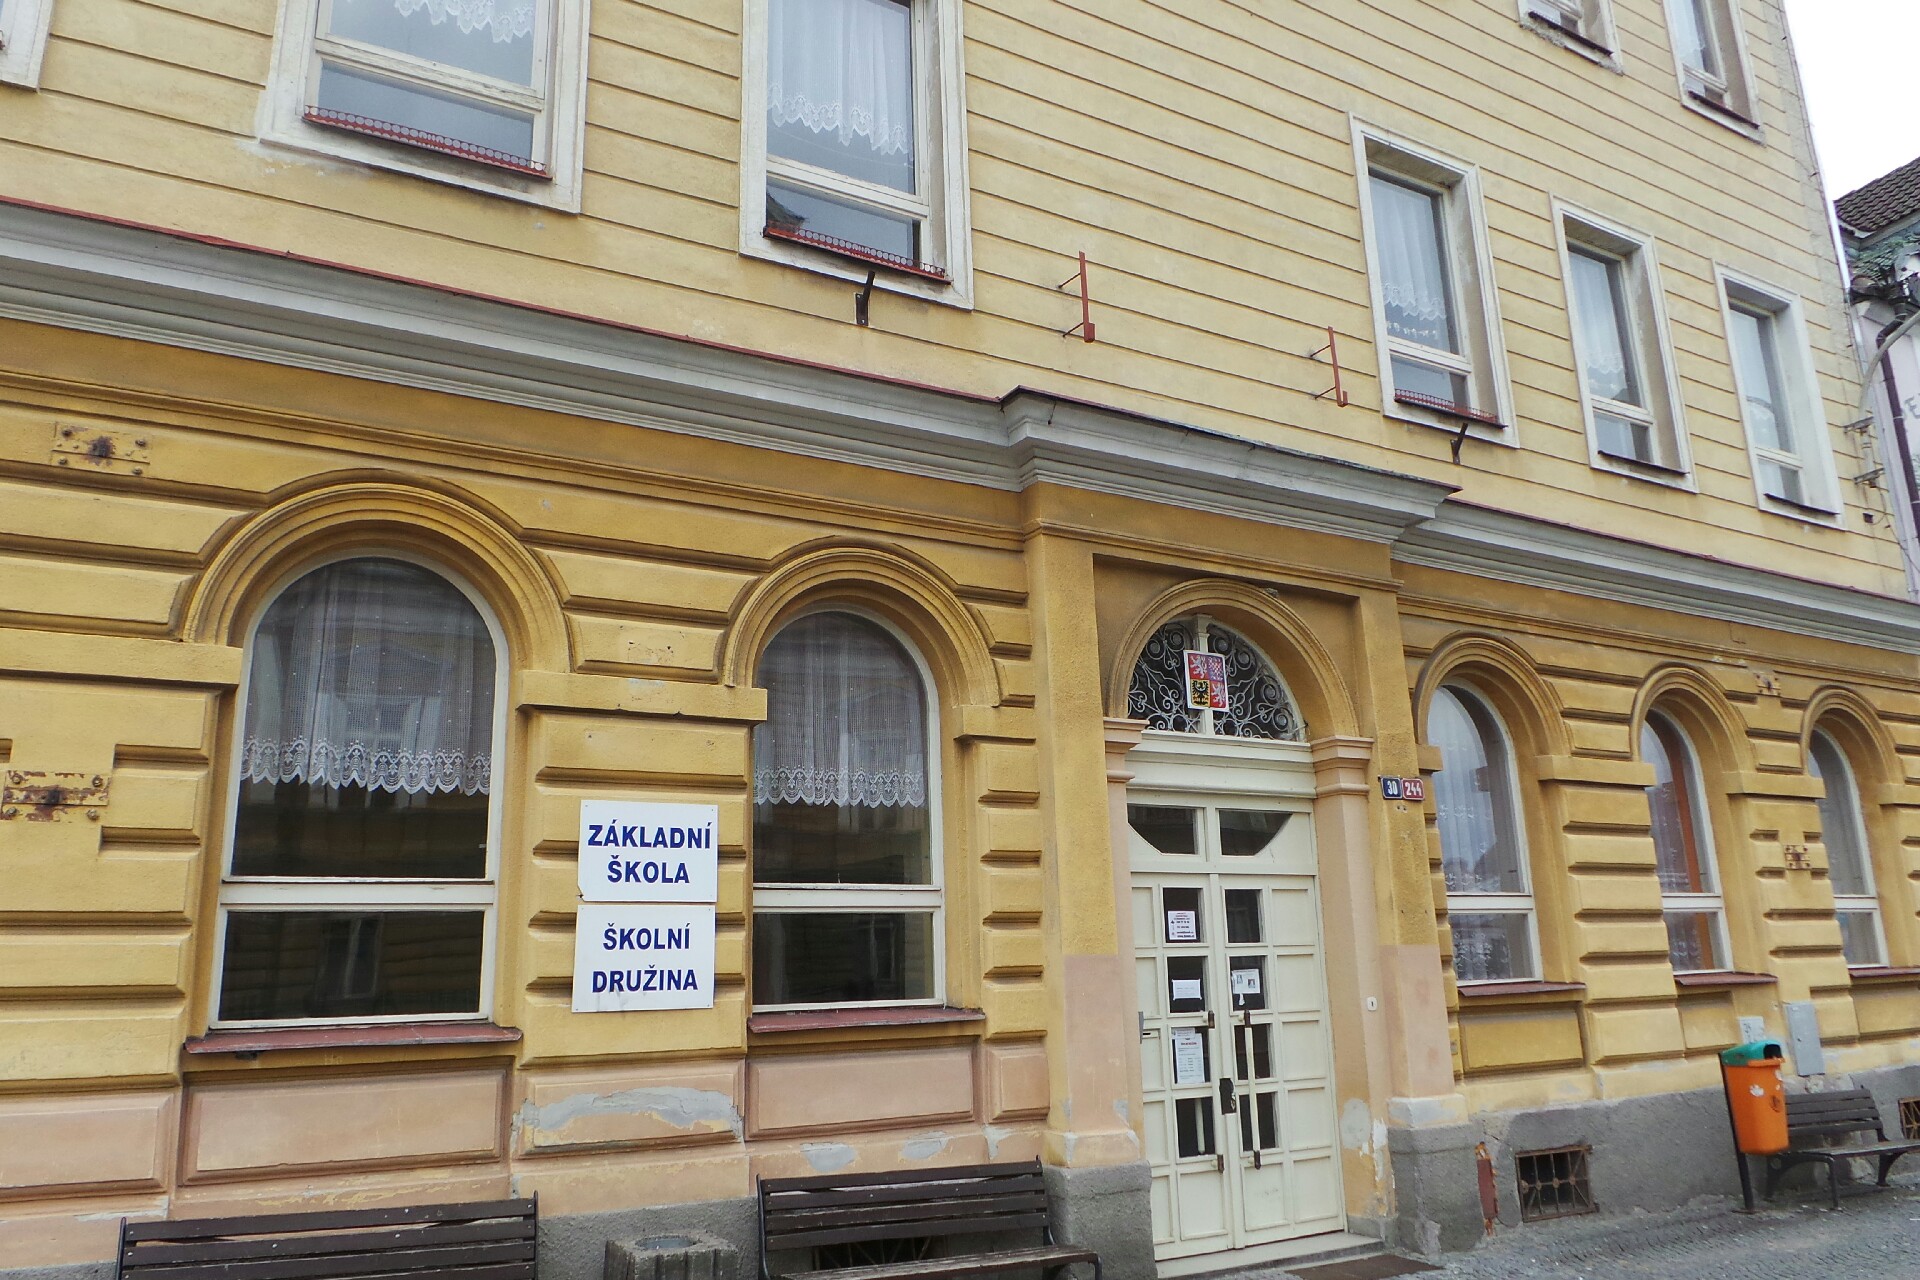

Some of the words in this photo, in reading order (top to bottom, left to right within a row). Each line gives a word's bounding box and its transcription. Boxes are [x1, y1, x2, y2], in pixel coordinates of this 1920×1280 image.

[1387, 780, 1398, 795] 30
[1404, 781, 1422, 796] 244
[588, 819, 712, 849] ZÁKLADNÍ
[607, 855, 690, 884] ŠKOLA
[603, 922, 691, 950] ŠKOLNÍ
[592, 963, 698, 993] DRUŽINA
